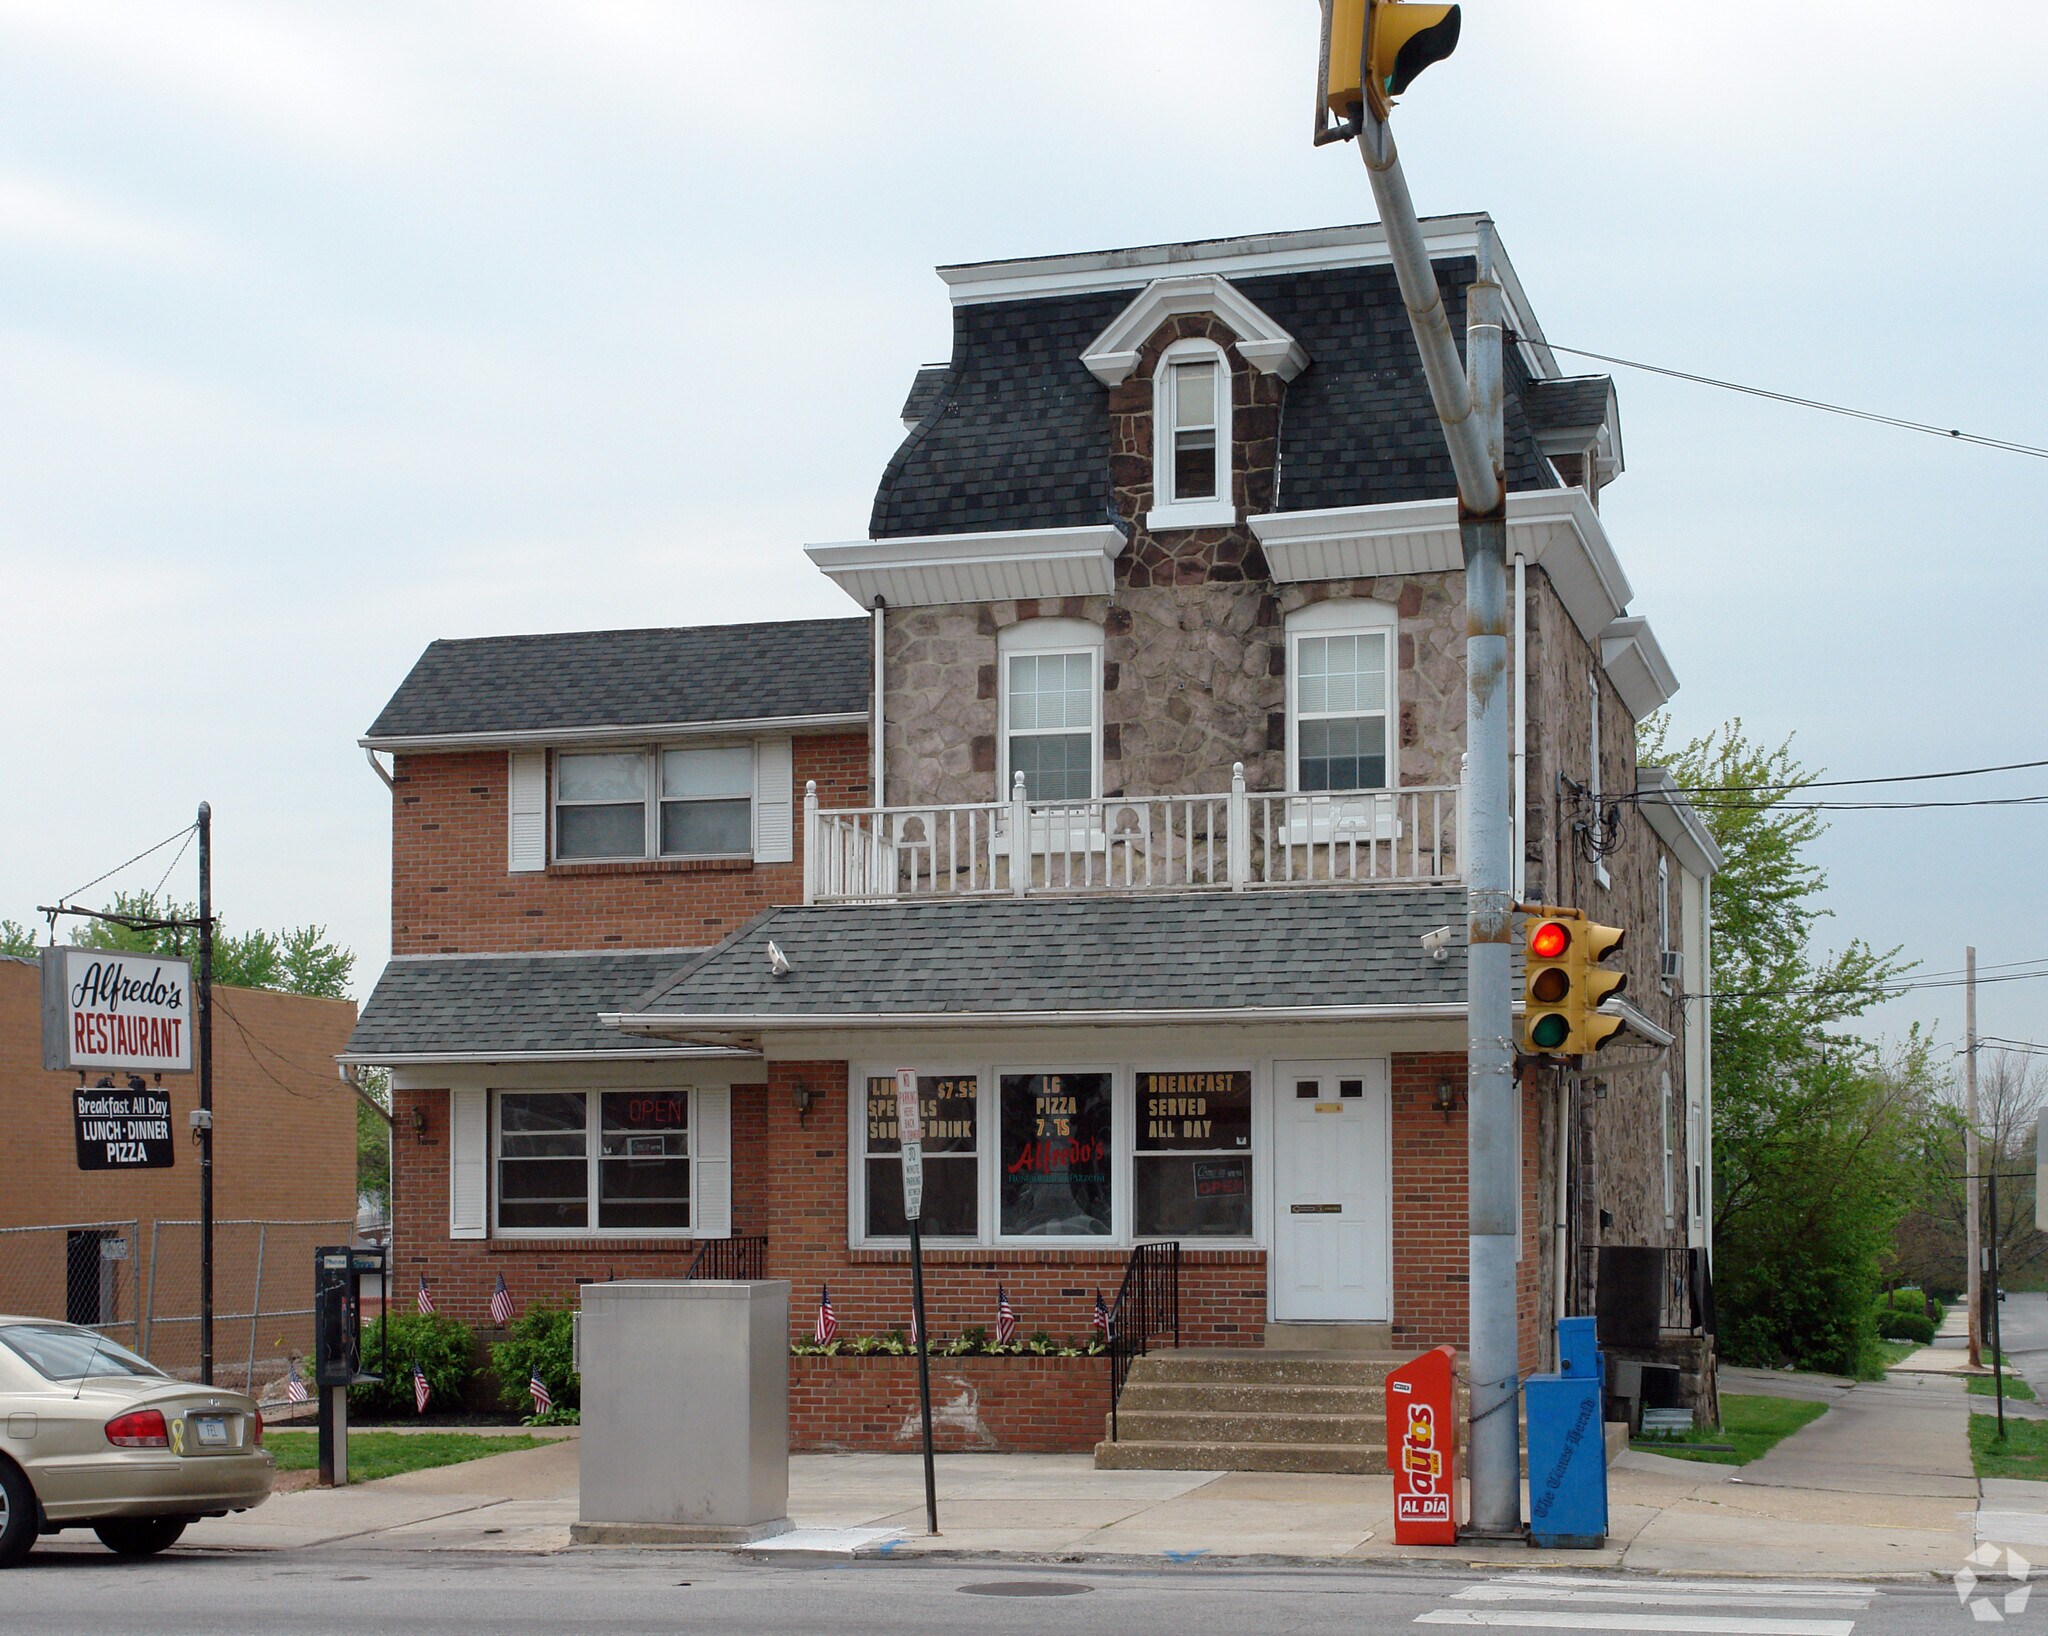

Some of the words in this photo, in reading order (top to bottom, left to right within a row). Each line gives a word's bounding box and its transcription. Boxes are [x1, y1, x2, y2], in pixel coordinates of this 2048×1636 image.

[72, 962, 183, 1012] Alfredo's
[74, 1012, 182, 1058] RESTAURANT
[1148, 1074, 1234, 1093] BREAKFAST
[78, 1096, 130, 1119] Breakfast
[132, 1097, 146, 1114] All
[148, 1097, 168, 1119] Day
[629, 1099, 681, 1123] OPEN
[868, 1099, 937, 1117] SPELS
[1036, 1097, 1077, 1114] PIZZA
[1148, 1098, 1207, 1116] SERVED
[83, 1120, 122, 1141] LUNCH
[127, 1120, 169, 1140] DINNER
[929, 1120, 972, 1138] DRINK
[1148, 1120, 1175, 1138] ALL
[1183, 1120, 1212, 1138] DAY
[106, 1142, 148, 1163] PIZZA
[1008, 1136, 1105, 1175] Alfredo's
[1406, 1407, 1432, 1495] autos
[1402, 1500, 1420, 1513] AL
[1423, 1497, 1446, 1513] DÍA
